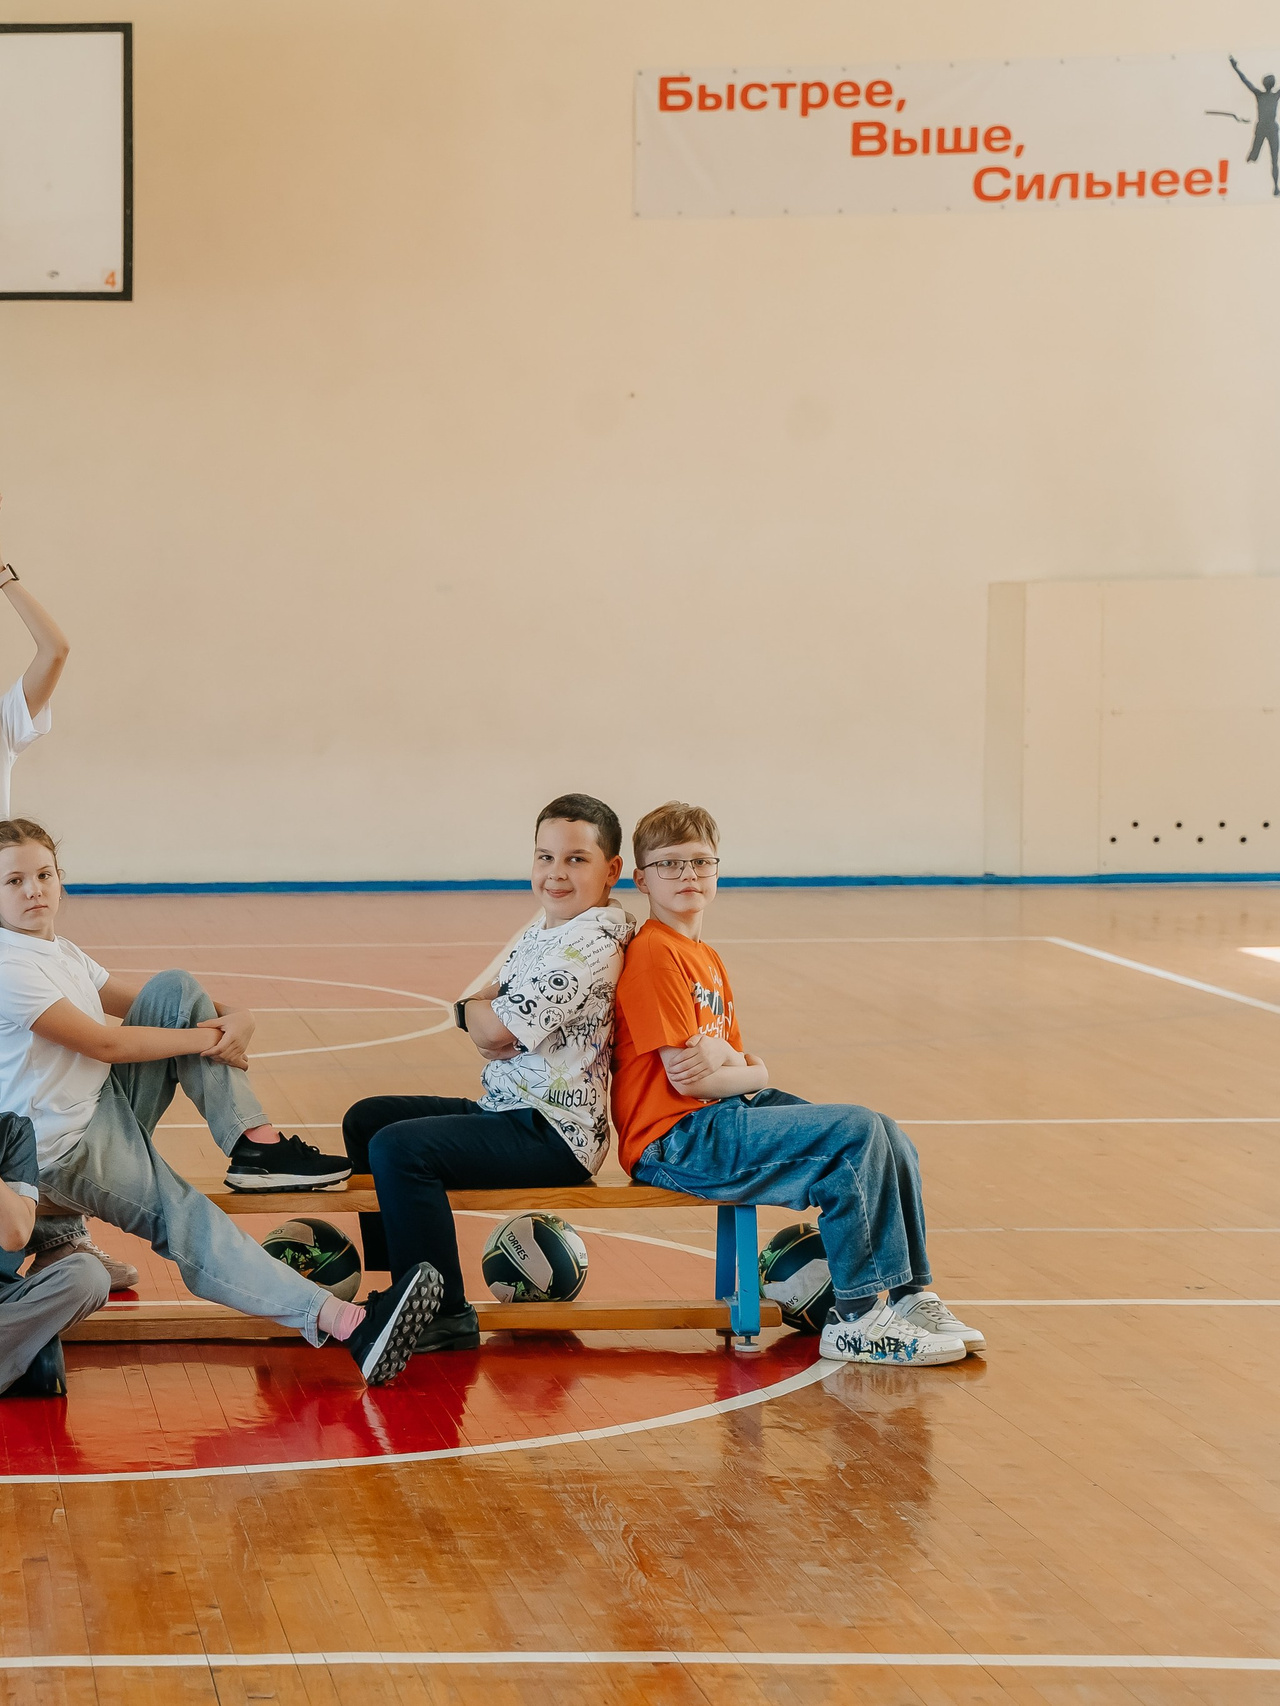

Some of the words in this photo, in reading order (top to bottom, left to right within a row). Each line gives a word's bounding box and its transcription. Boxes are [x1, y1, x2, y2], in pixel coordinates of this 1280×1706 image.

[658, 75, 907, 118] Быстрее,
[850, 120, 1025, 159] Выше,
[972, 159, 1229, 203] Сильнее!
[506, 1231, 529, 1261] TORRES
